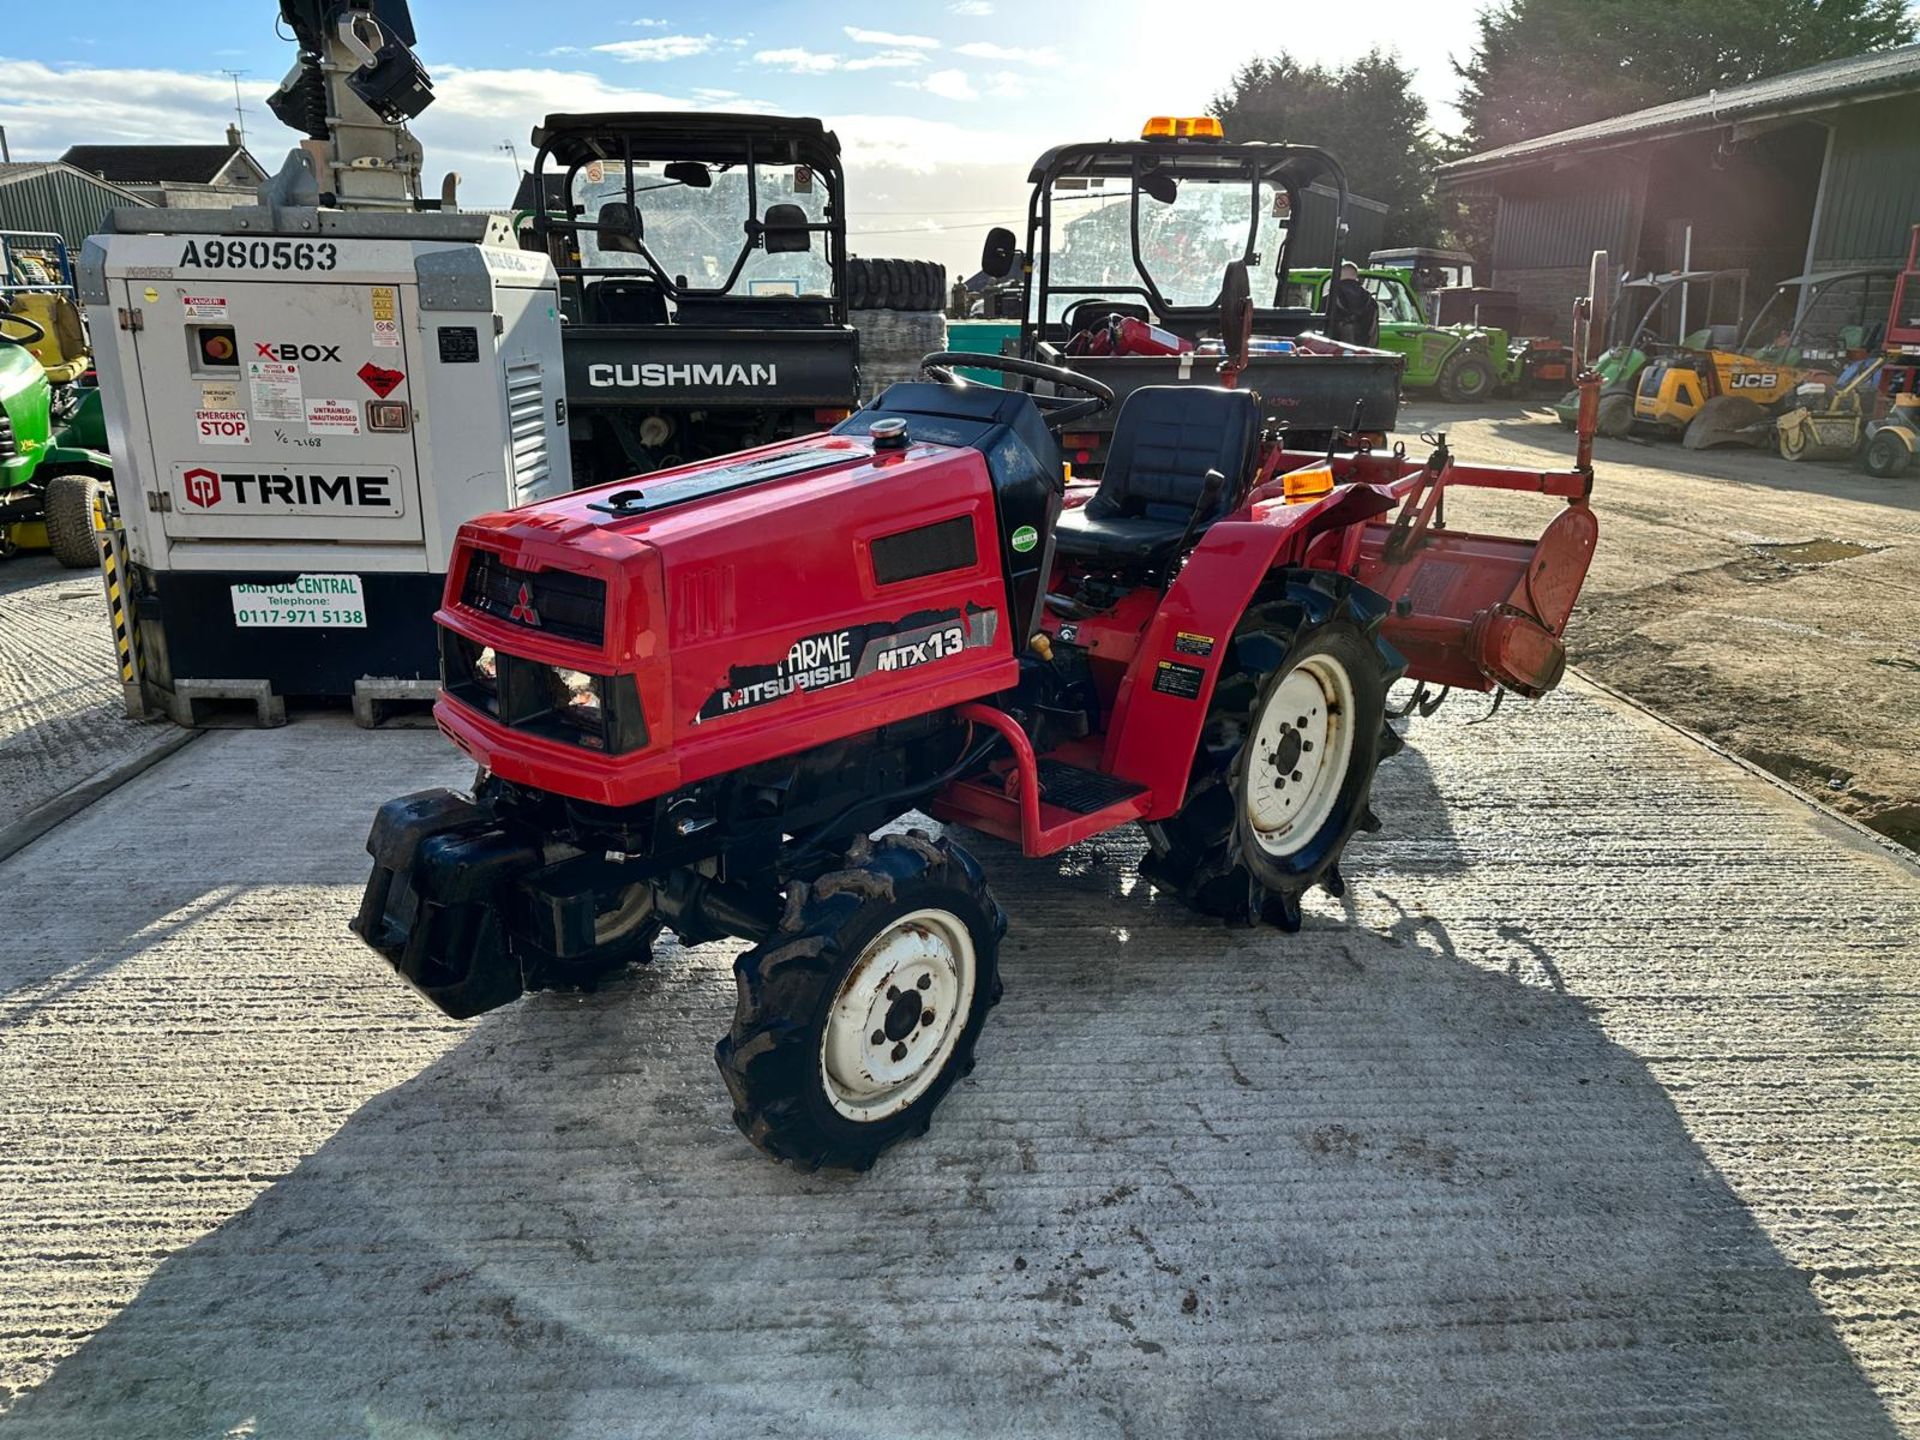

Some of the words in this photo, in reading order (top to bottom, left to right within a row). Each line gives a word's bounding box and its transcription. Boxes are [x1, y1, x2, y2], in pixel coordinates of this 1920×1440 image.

[179, 240, 337, 271] A980563
[255, 342, 342, 362] X-BOX
[588, 363, 777, 387] CUSHMAN
[1731, 374, 1777, 388] JCB
[197, 411, 246, 420] EMERGENCY
[201, 421, 246, 436] STOP
[221, 474, 391, 506] TRIME
[296, 578, 357, 594] CENTRAL
[268, 596, 330, 606] Telephone:
[239, 609, 316, 623] 0117-971
[322, 610, 363, 623] 5138
[777, 632, 850, 676] ARMIE
[722, 663, 852, 710] MITSUBISHI
